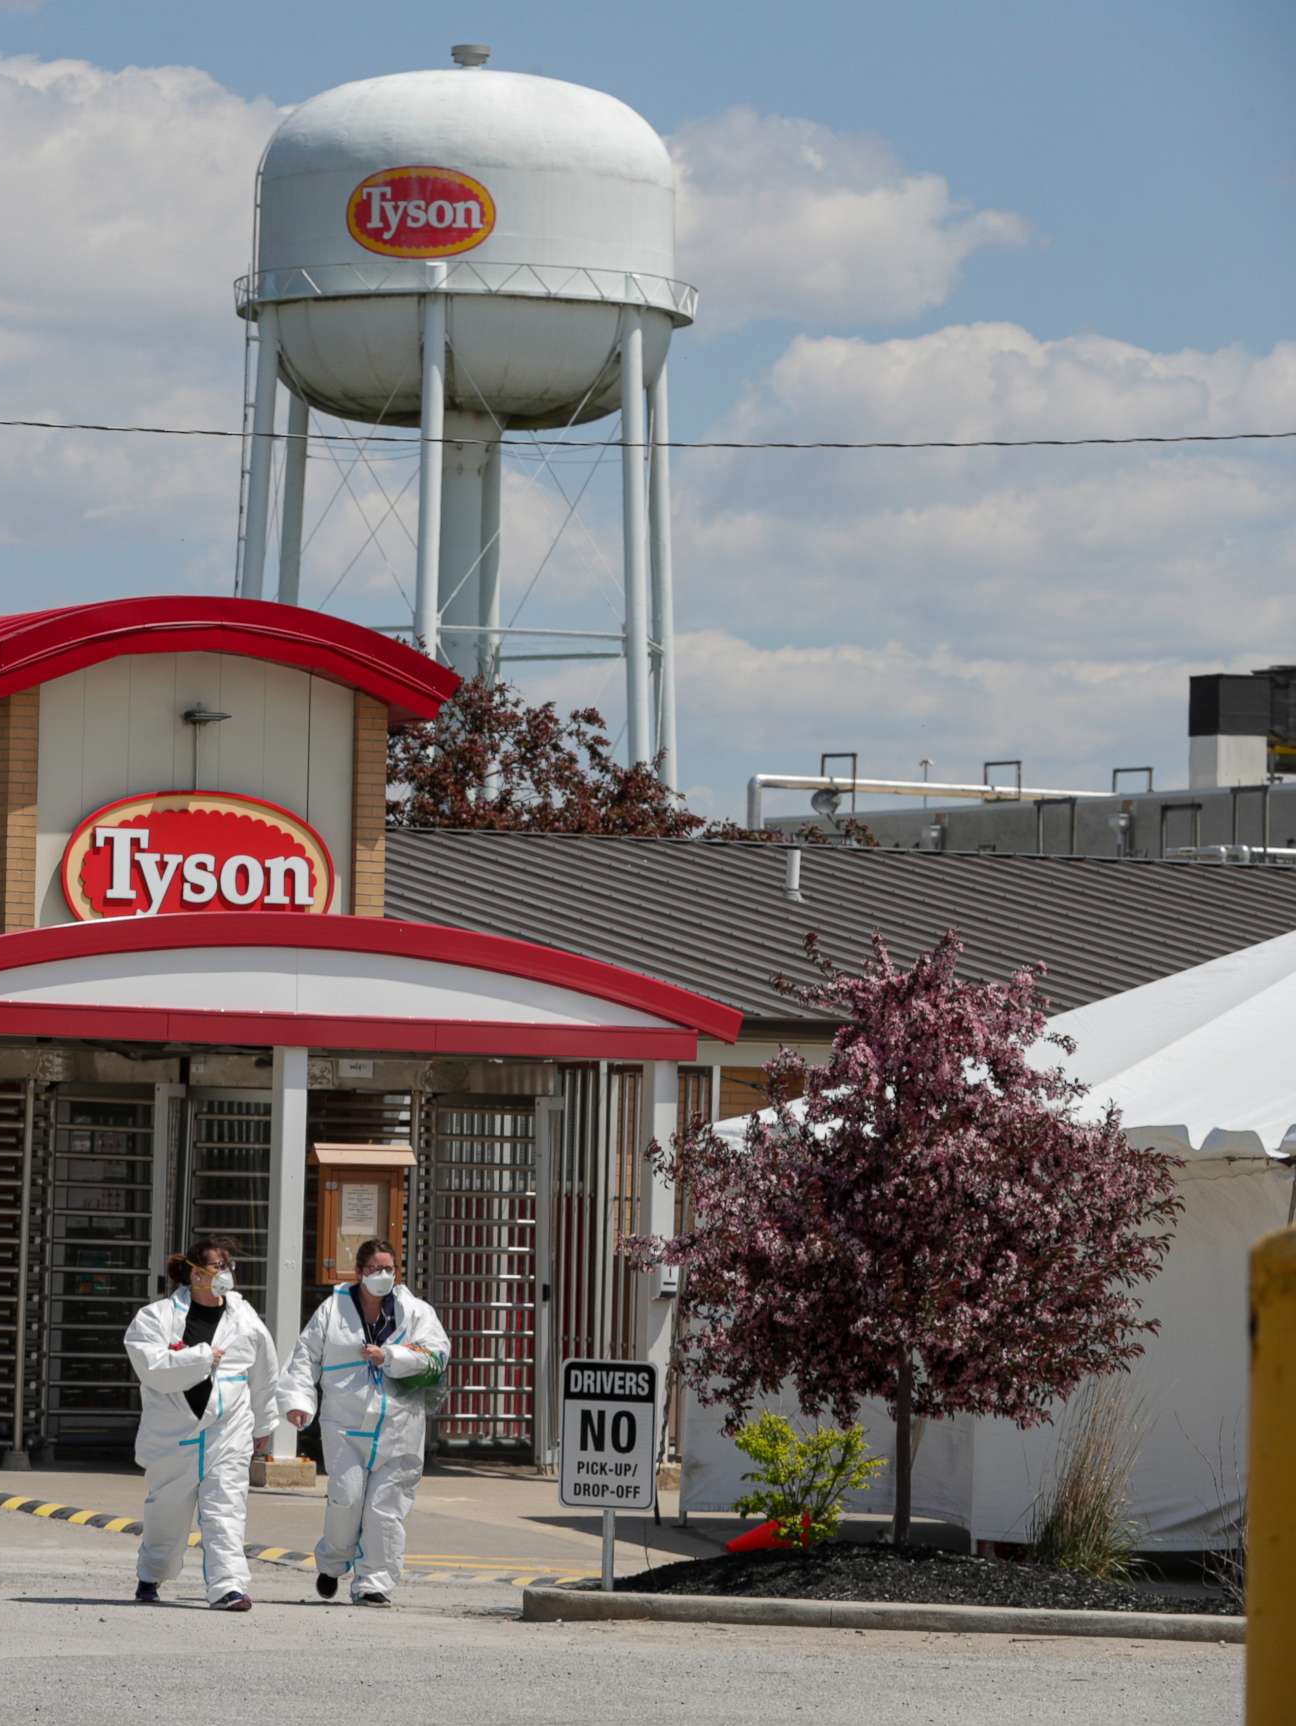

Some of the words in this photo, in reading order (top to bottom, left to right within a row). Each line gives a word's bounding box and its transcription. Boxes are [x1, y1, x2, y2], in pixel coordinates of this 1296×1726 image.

[362, 186, 483, 240] Tyson
[95, 827, 315, 915] Tyson
[570, 1369, 649, 1396] DRIVERS
[580, 1409, 637, 1454] NO
[577, 1461, 638, 1477] PICK-UP/
[574, 1483, 641, 1499] DROP-OFF
